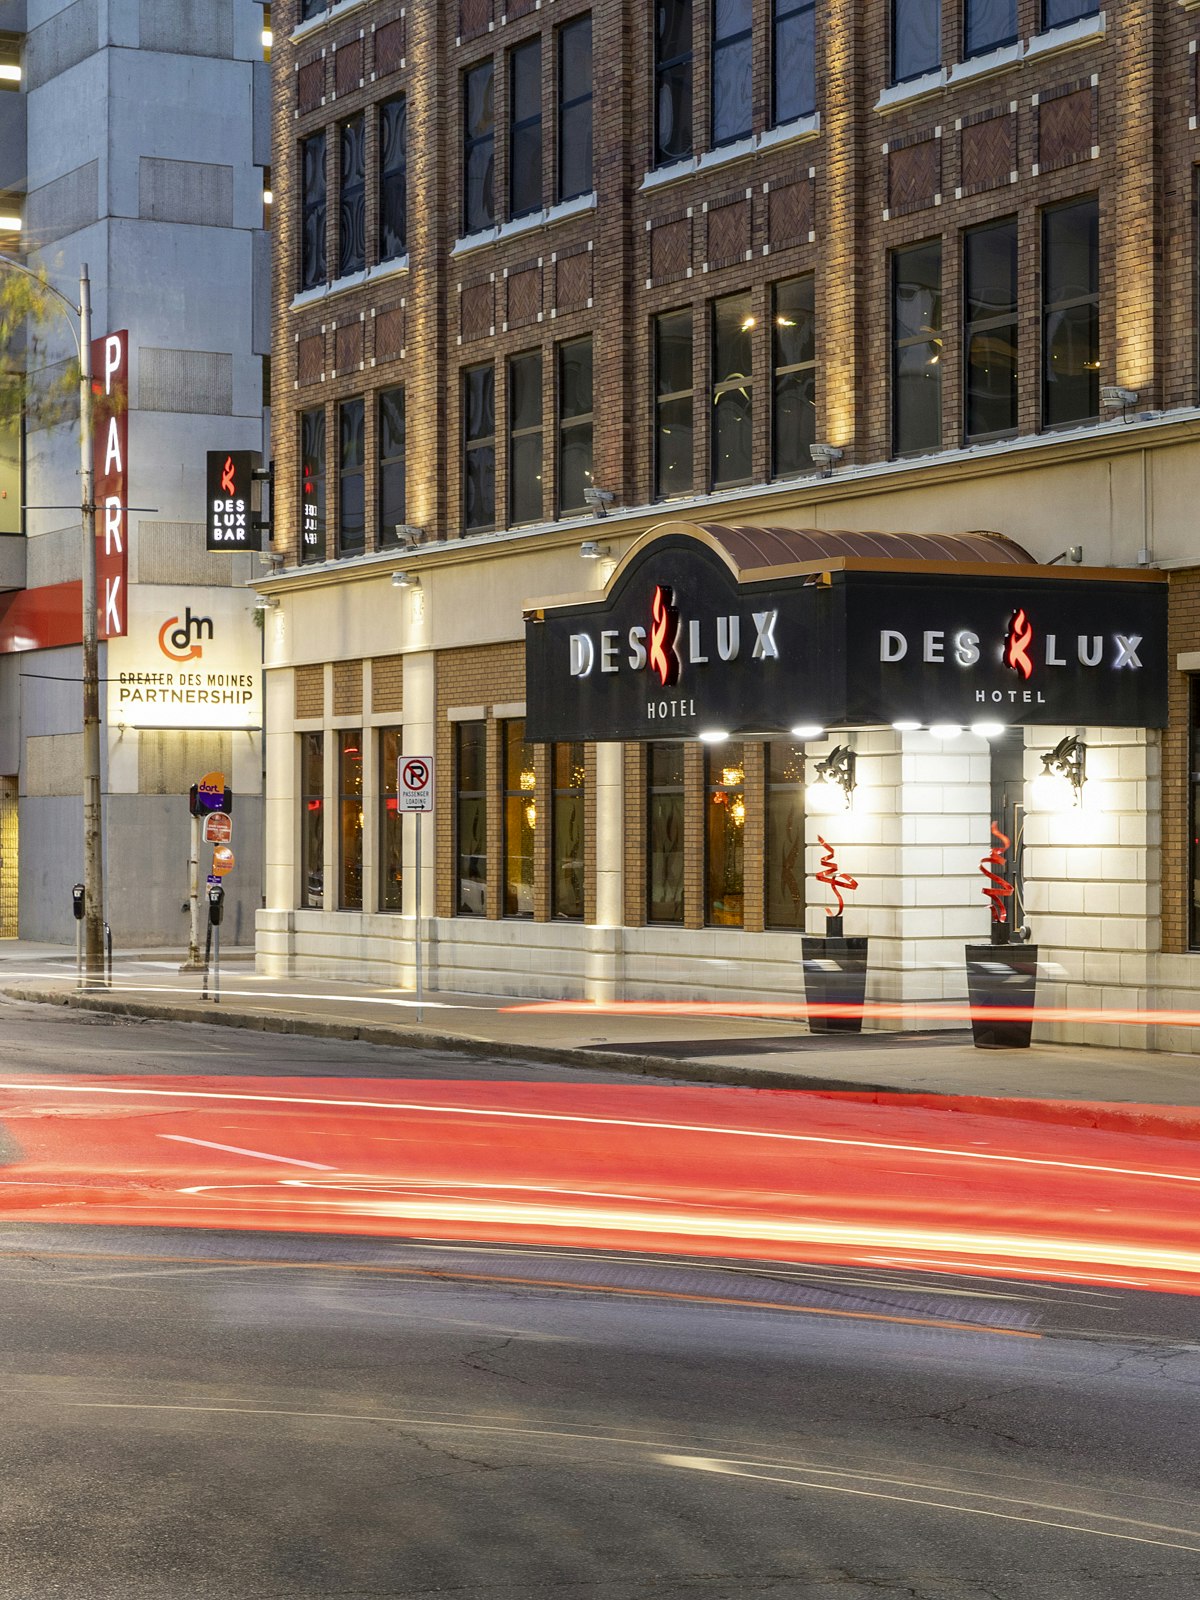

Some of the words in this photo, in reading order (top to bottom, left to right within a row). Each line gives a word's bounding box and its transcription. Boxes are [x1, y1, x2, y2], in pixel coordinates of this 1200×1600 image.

[105, 335, 121, 635] PARK
[214, 500, 245, 512] DES
[214, 514, 245, 526] LUX
[214, 528, 245, 540] BAR
[569, 626, 647, 677] DES
[689, 609, 779, 664] LUX
[880, 630, 980, 666] DES
[1046, 634, 1143, 668] LUX
[120, 672, 173, 685] GREATER
[180, 674, 201, 686] DES
[207, 674, 253, 687] MOINES
[120, 688, 253, 704] PARTNERSHIP
[975, 690, 1046, 703] HOTEL
[648, 699, 696, 719] HOTEL
[200, 782, 219, 792] dart
